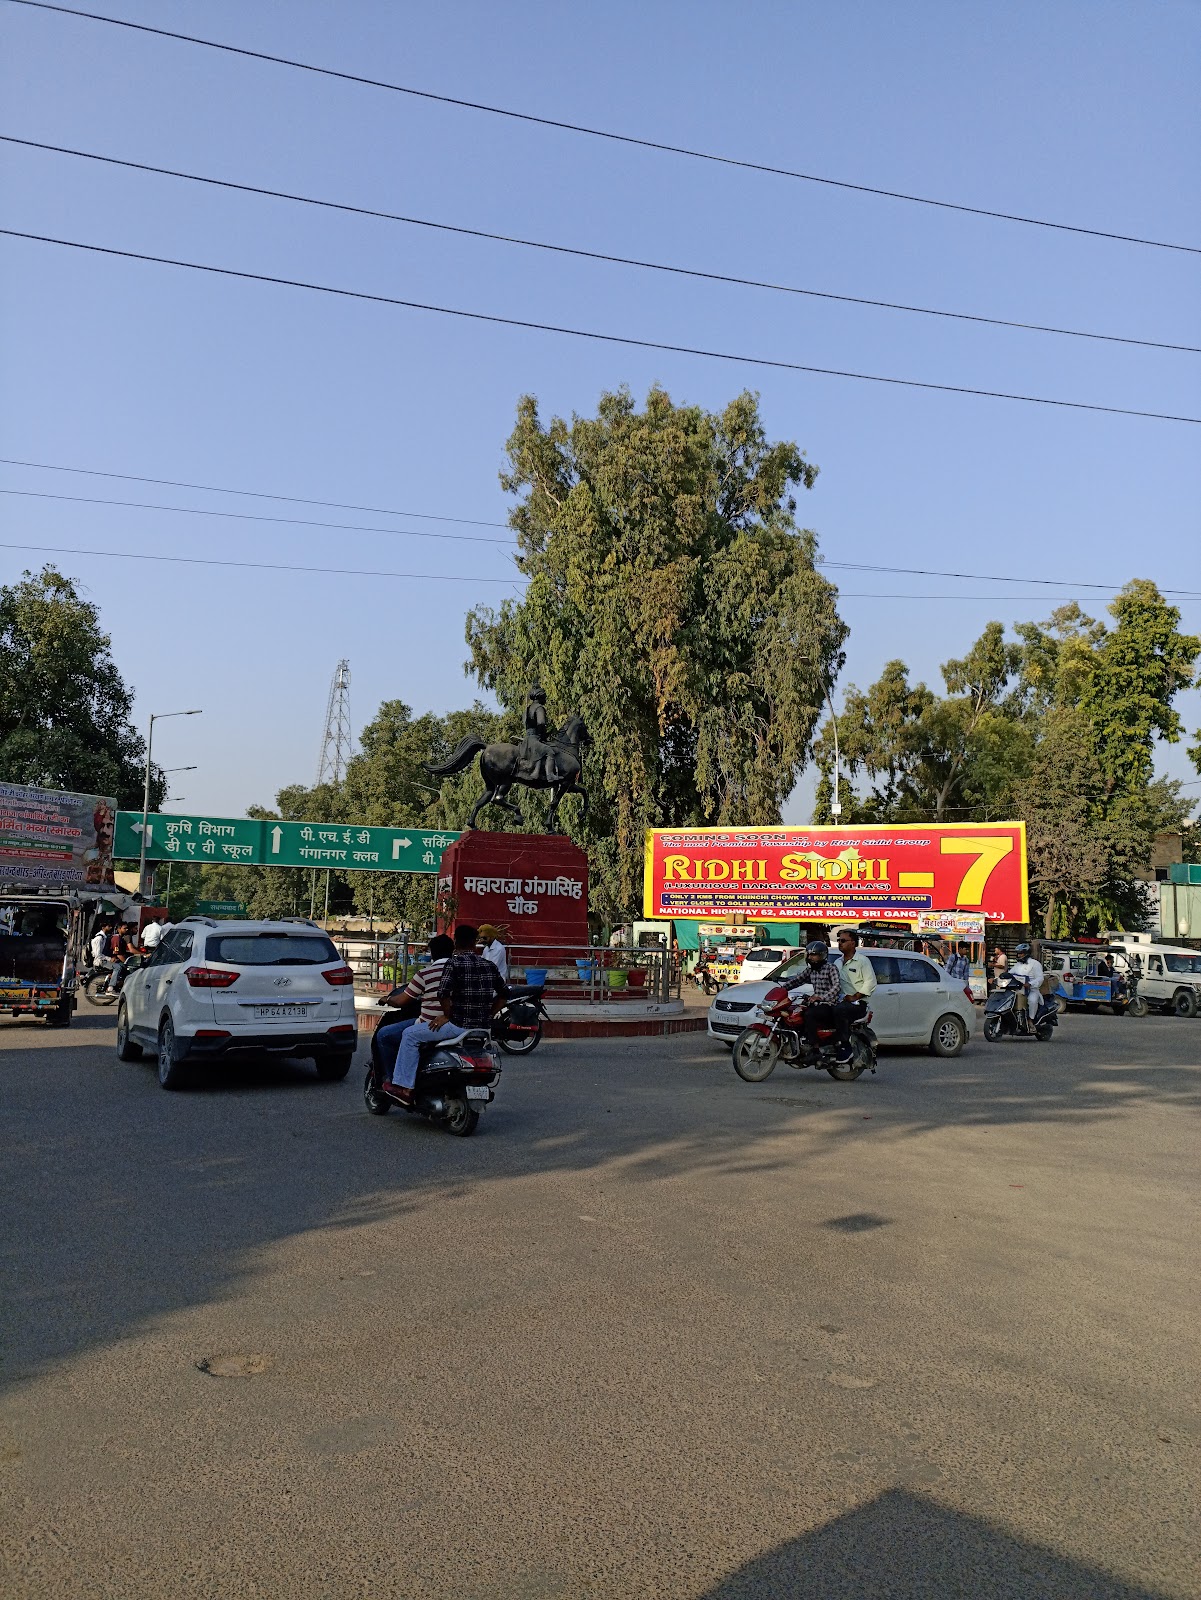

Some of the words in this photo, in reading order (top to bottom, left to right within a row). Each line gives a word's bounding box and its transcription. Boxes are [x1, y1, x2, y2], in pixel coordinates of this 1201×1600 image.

[26, 824, 47, 833] भव्य
[49, 826, 82, 837] स्मारक
[166, 819, 192, 837] कृषि
[199, 821, 235, 837] विभाग
[300, 827, 315, 841] पी.
[318, 831, 339, 844] एच.
[342, 829, 354, 845] ई.
[357, 830, 370, 844] डी
[894, 838, 931, 846] Group
[164, 836, 180, 852] डी
[186, 842, 196, 855] ए
[202, 839, 215, 854] वी
[221, 844, 253, 859] स्कूल
[299, 845, 347, 860] गंगानगर
[353, 851, 379, 862] क्लब
[422, 851, 436, 865] बी.
[463, 876, 523, 896] महाराजा
[524, 875, 583, 899] गंगासिंह
[664, 882, 739, 890] (LUXURIOUS
[834, 883, 891, 891] VILLA'S)
[506, 895, 539, 915] चौक
[826, 910, 859, 918] ROAD,
[260, 1008, 270, 1016] HP
